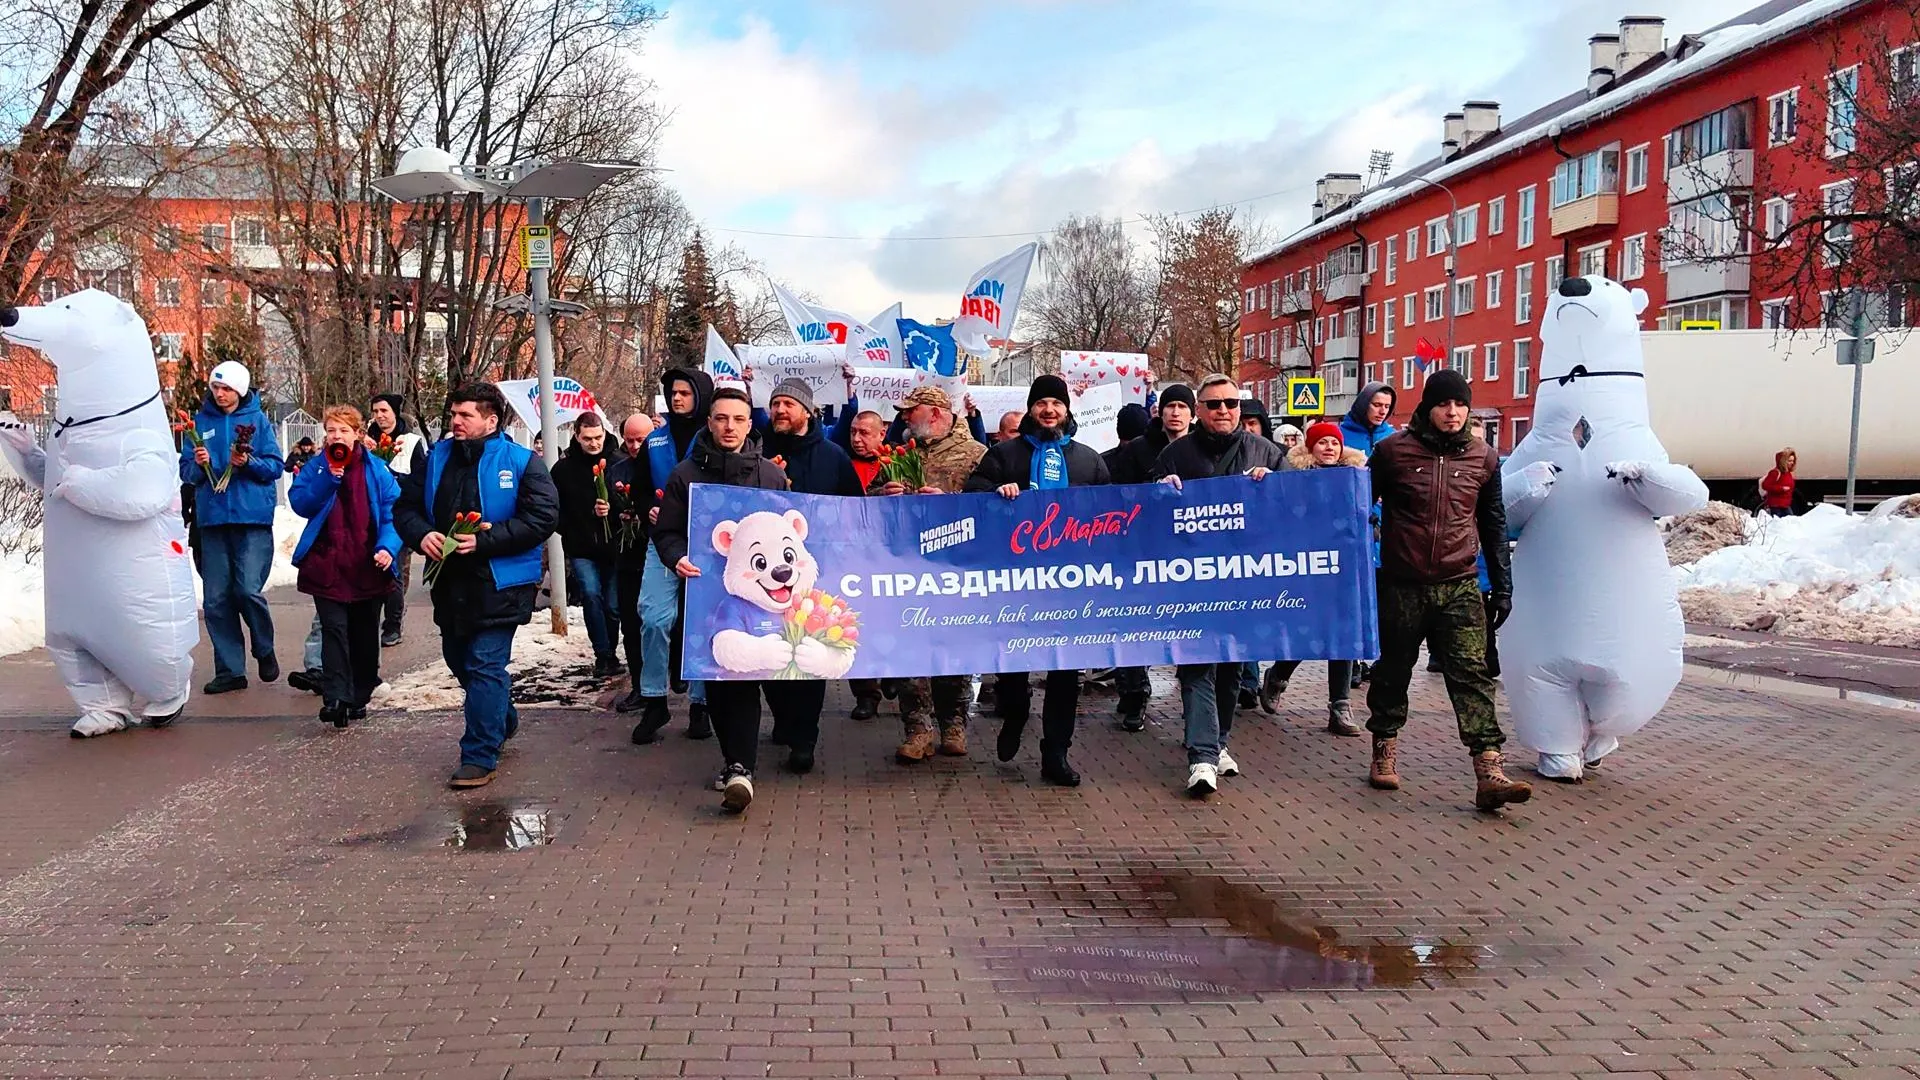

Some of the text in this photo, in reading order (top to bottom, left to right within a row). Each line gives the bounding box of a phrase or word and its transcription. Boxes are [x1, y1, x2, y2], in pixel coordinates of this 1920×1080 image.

[768, 352, 821, 366] Спасибо,
[784, 367, 805, 376] что
[803, 376, 828, 387] сть.
[852, 376, 911, 389] ОРОГИЕ
[1173, 503, 1244, 521] ЕДИНАЯ
[1032, 502, 1060, 554] 8
[1174, 517, 1245, 534] РОССИЯ
[840, 550, 1340, 598] С ПРАЗДНИКОМ, ЛЮБИМЫЕ!
[900, 590, 1307, 627] Мы знаем, как много в жизни держится на вас,
[1005, 628, 1202, 654] дорогие наши женщины
